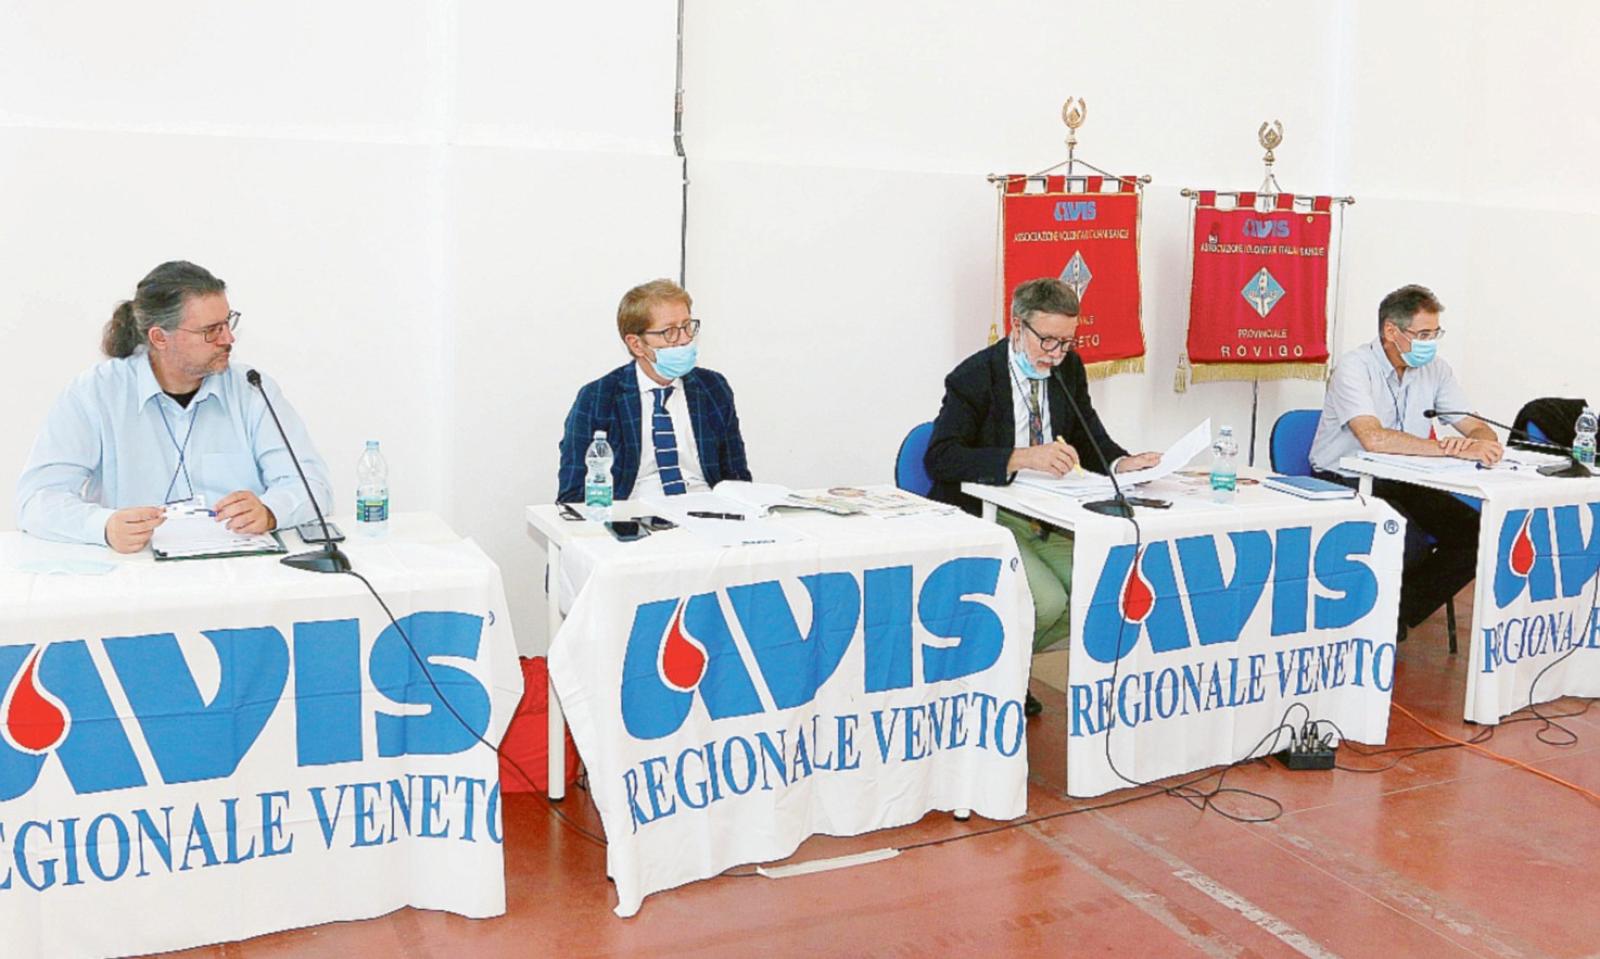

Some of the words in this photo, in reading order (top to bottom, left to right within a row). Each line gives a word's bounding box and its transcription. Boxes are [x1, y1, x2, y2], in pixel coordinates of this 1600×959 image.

[1220, 345, 1304, 358] ROVIGO
[621, 557, 1005, 740] AVIS
[1083, 521, 1378, 663] AVIS
[1070, 653, 1266, 737] REGIONALE
[1276, 638, 1397, 698] VENETO
[622, 714, 861, 835] REGIONALE
[870, 692, 1024, 764] VENETO
